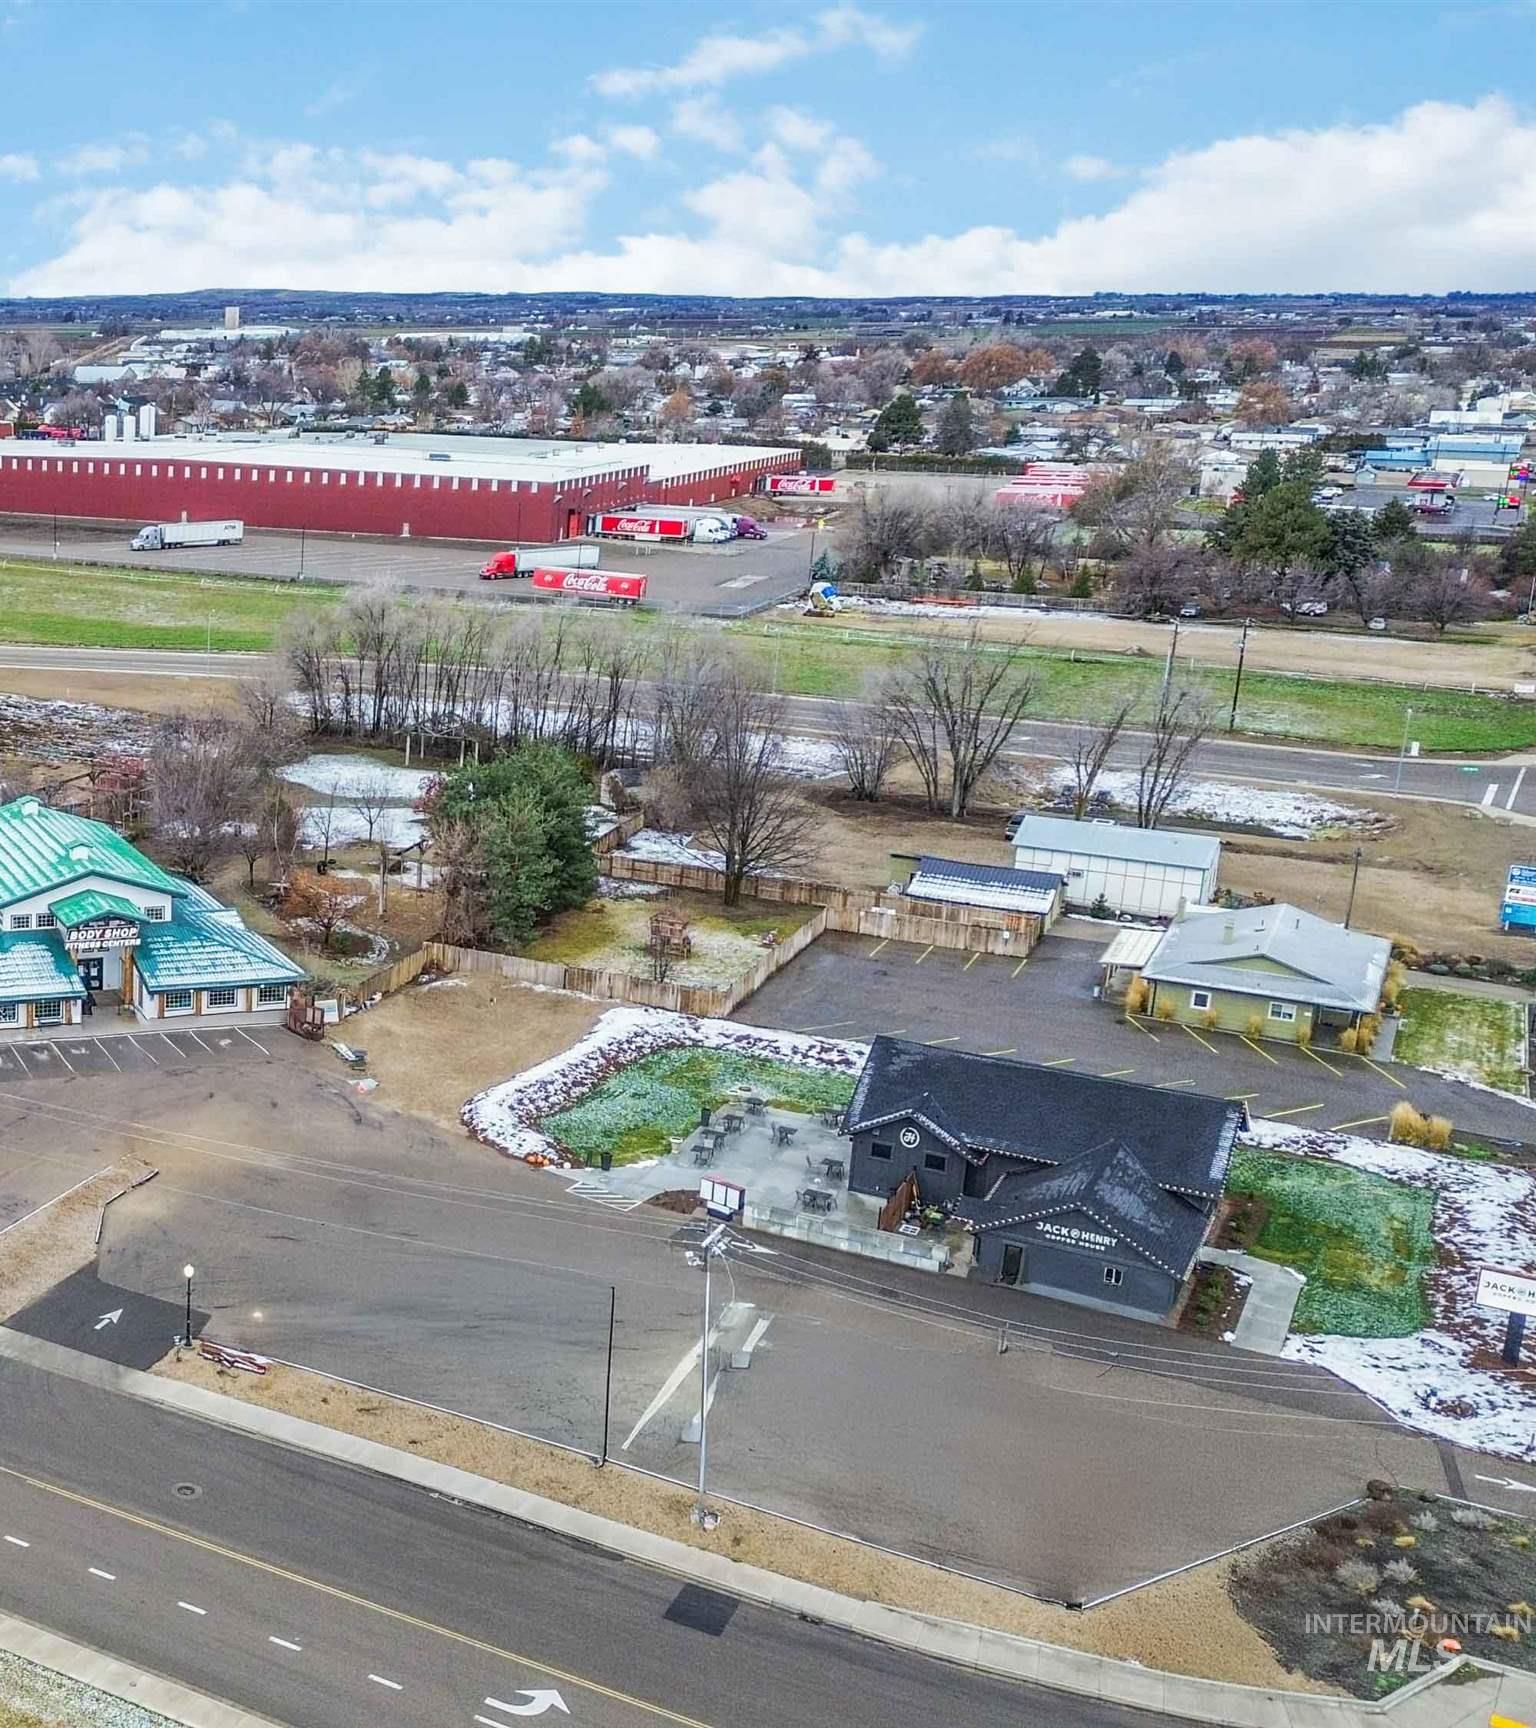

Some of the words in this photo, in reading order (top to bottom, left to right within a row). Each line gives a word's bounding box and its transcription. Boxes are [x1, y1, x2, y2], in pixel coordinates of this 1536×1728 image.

[70, 930, 104, 940] BODY
[104, 927, 138, 938] SHOP
[1035, 1221, 1070, 1236] JACK
[1081, 1231, 1119, 1247] HENRY
[1483, 1281, 1516, 1294] JACK
